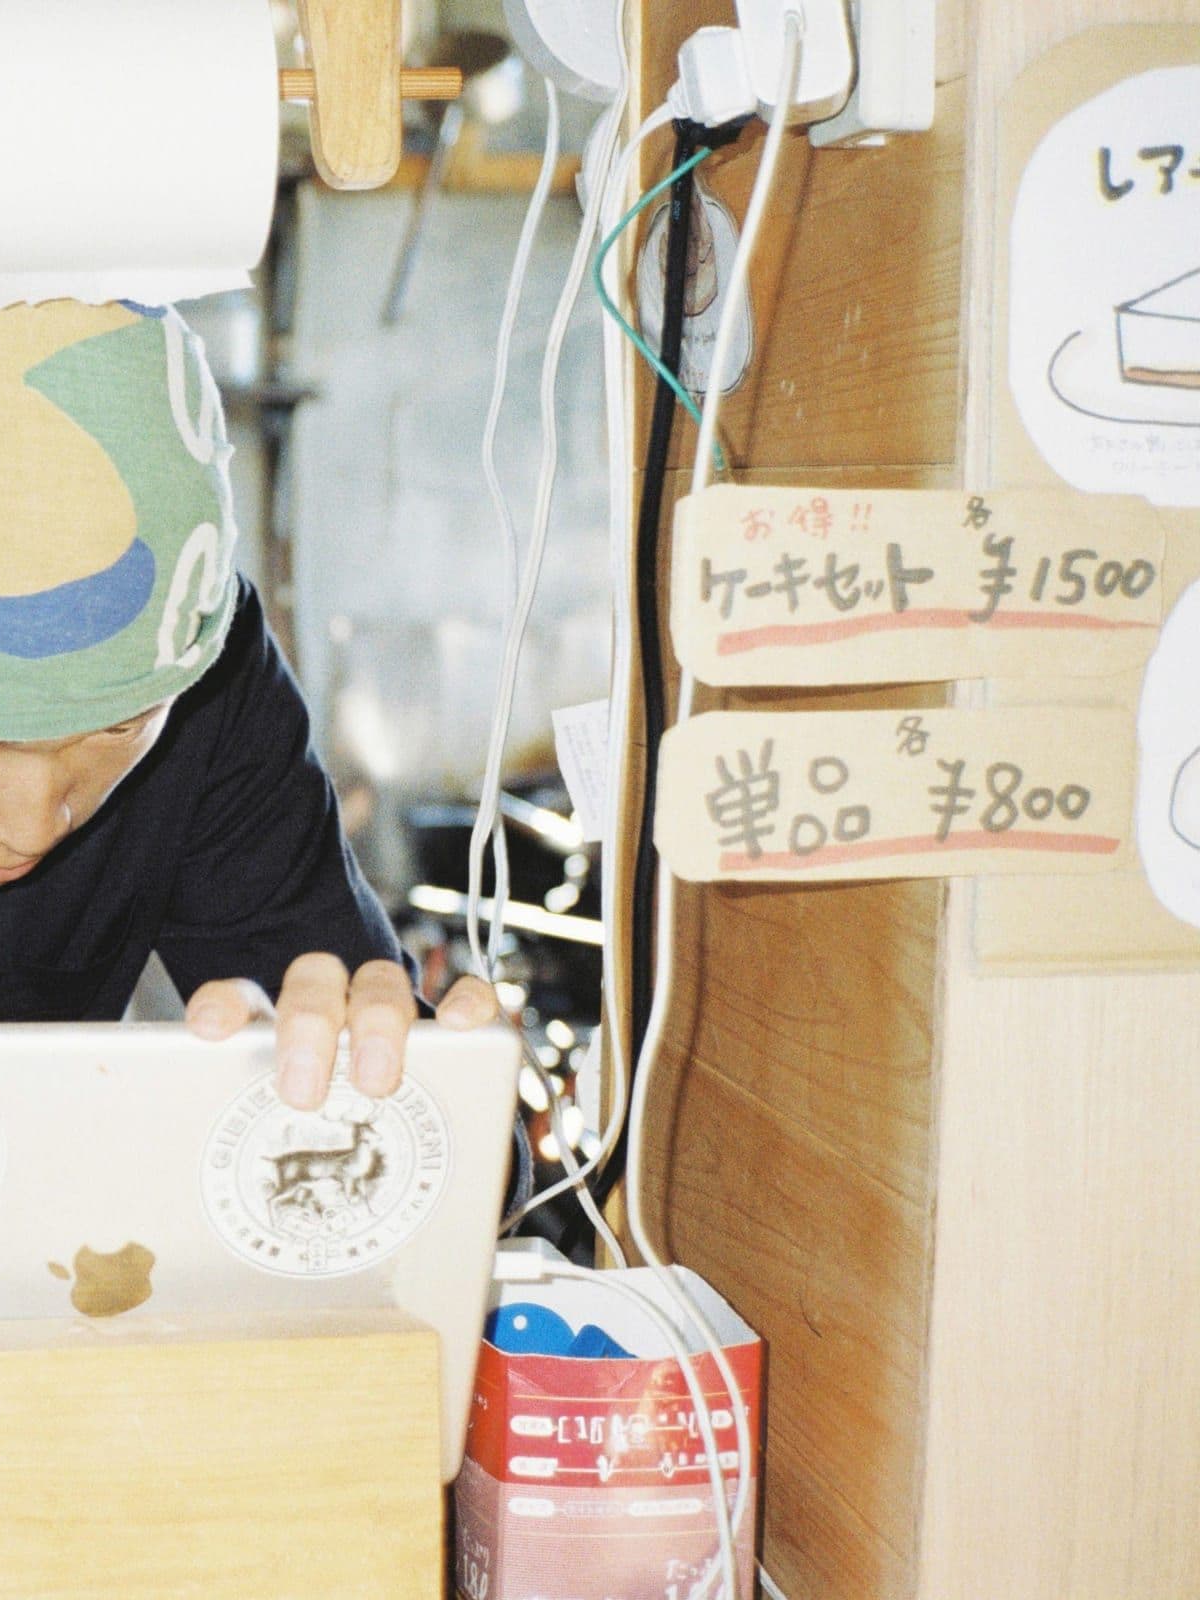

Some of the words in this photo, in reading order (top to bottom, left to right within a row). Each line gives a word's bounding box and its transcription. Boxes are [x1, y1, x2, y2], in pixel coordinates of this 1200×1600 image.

[699, 543, 934, 621] ケーキセット
[968, 533, 1158, 622] ¥1500
[705, 738, 871, 859] 単品
[927, 758, 1092, 843] ¥800
